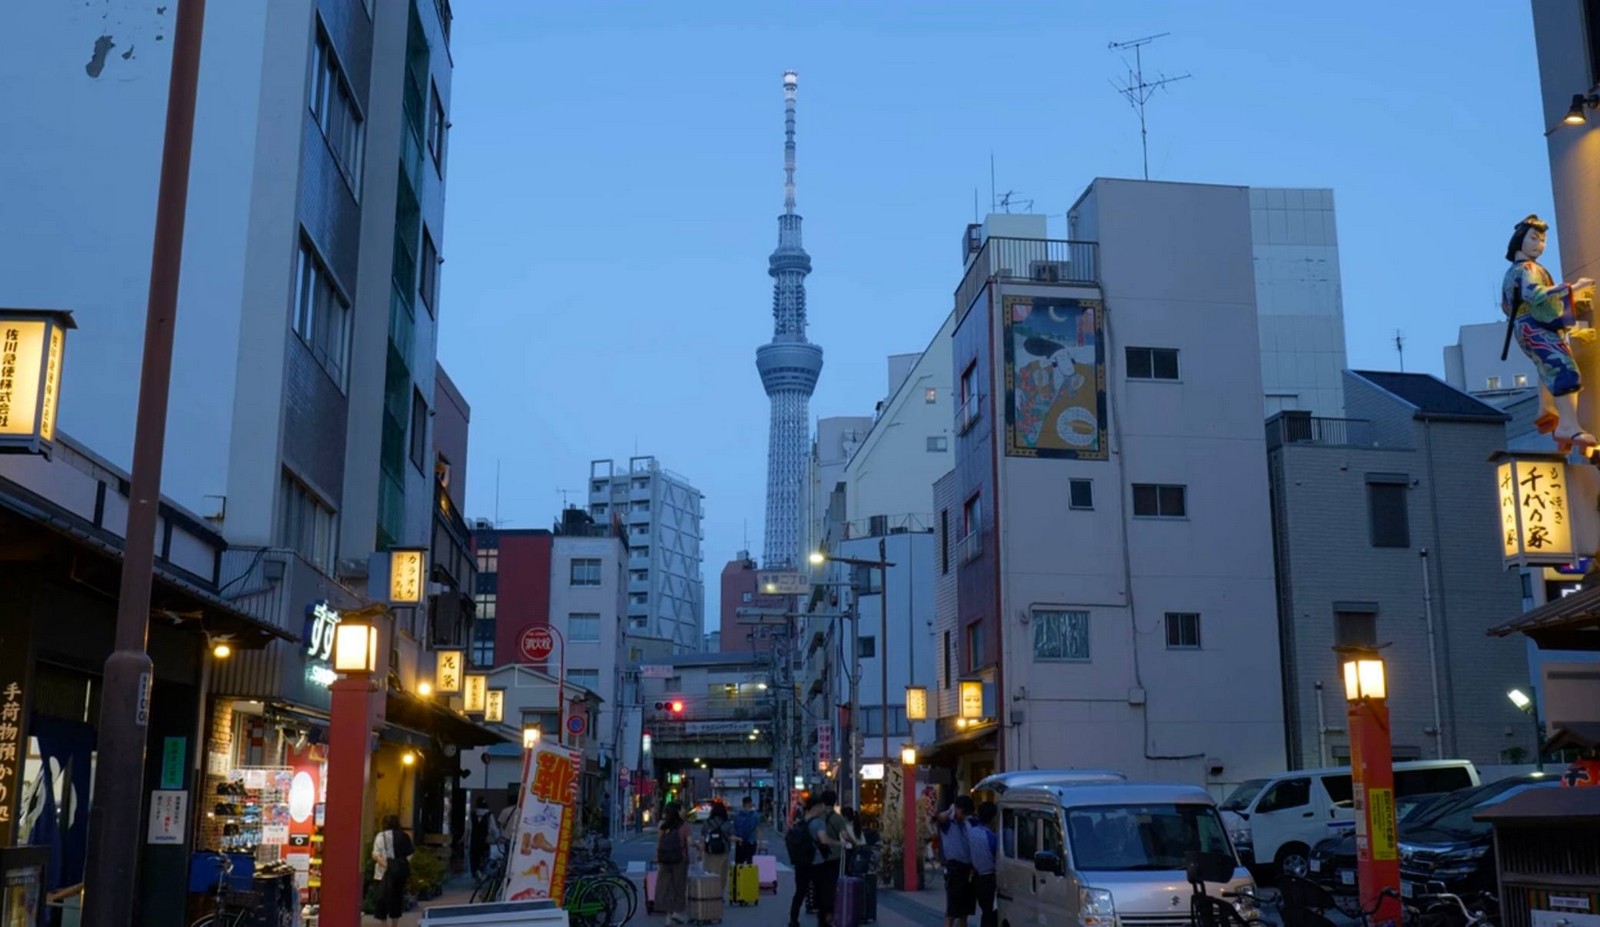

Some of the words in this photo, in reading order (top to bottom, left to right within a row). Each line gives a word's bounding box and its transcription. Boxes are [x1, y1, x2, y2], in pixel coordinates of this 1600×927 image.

[525, 637, 552, 650] 消火栓
[532, 751, 574, 806] 靴
